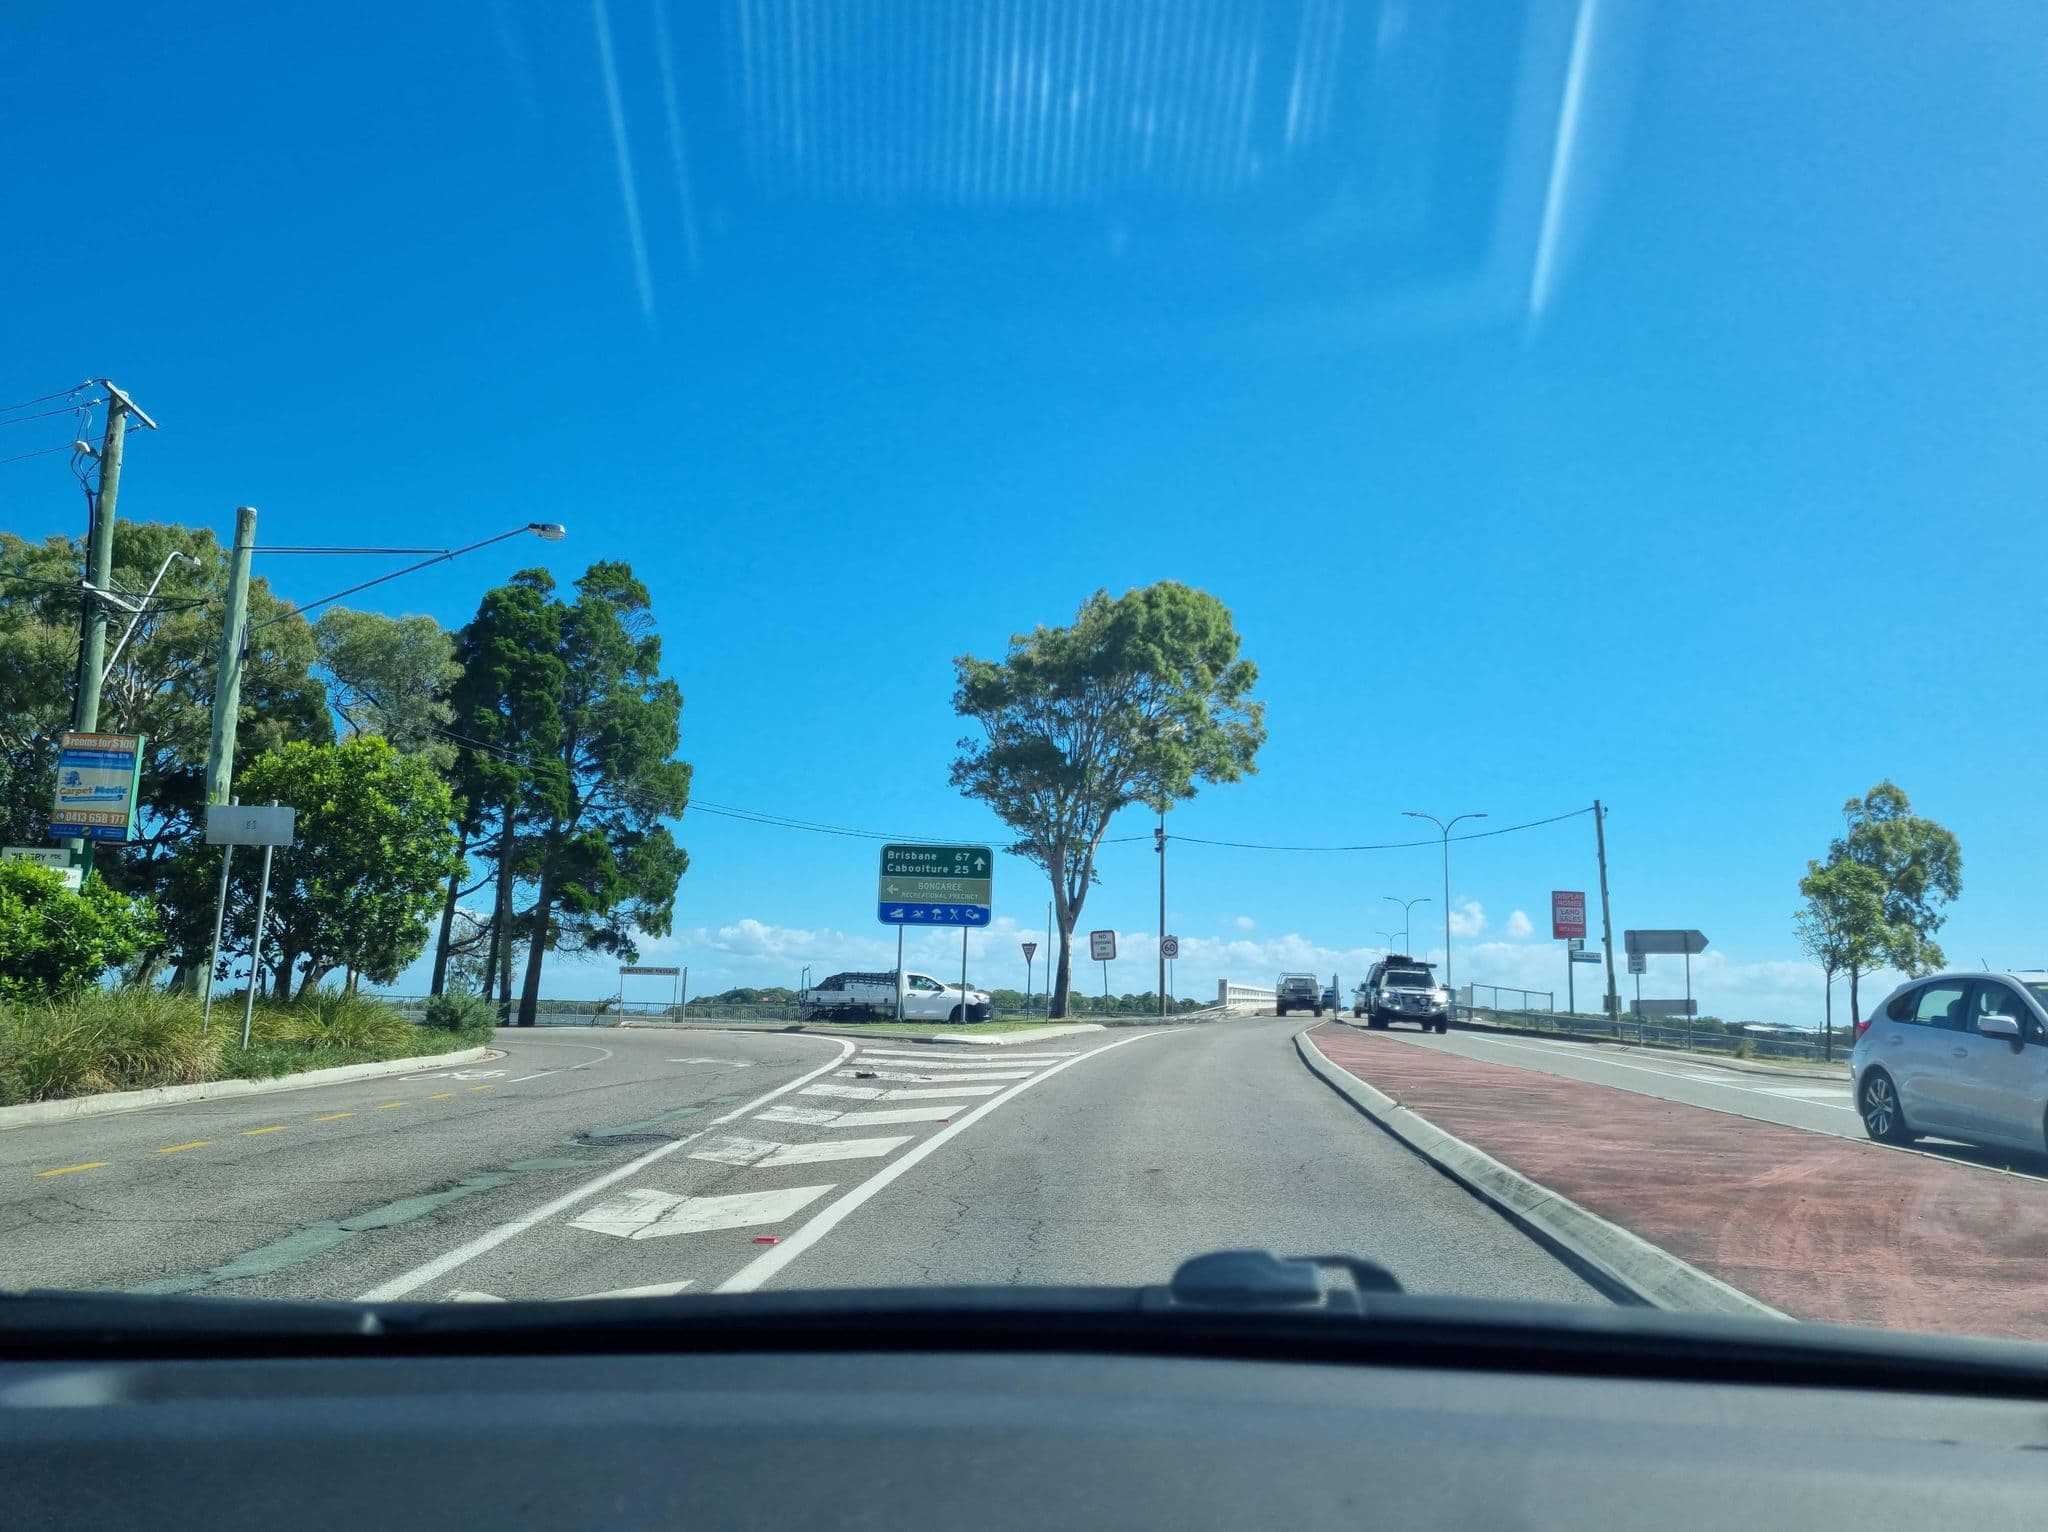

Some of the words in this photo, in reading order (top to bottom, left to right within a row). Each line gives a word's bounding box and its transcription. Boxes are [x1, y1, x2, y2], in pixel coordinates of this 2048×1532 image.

[71, 738, 97, 746] rooms
[98, 738, 112, 748] for
[113, 739, 136, 748] $100
[59, 786, 93, 796] Carpet
[95, 785, 128, 794] Medic
[66, 812, 87, 823] 0413
[88, 813, 108, 824] 658
[111, 814, 125, 825] 177
[887, 850, 937, 860] Brisbane
[955, 852, 970, 862] 67
[887, 863, 949, 874] Caboolture
[954, 865, 970, 874] 25
[918, 882, 963, 891] BONGAREE
[901, 892, 947, 900] RECREATIONAL
[949, 893, 978, 901] PRECINCT
[1557, 899, 1582, 907] HOMES
[1164, 943, 1176, 952] 60
